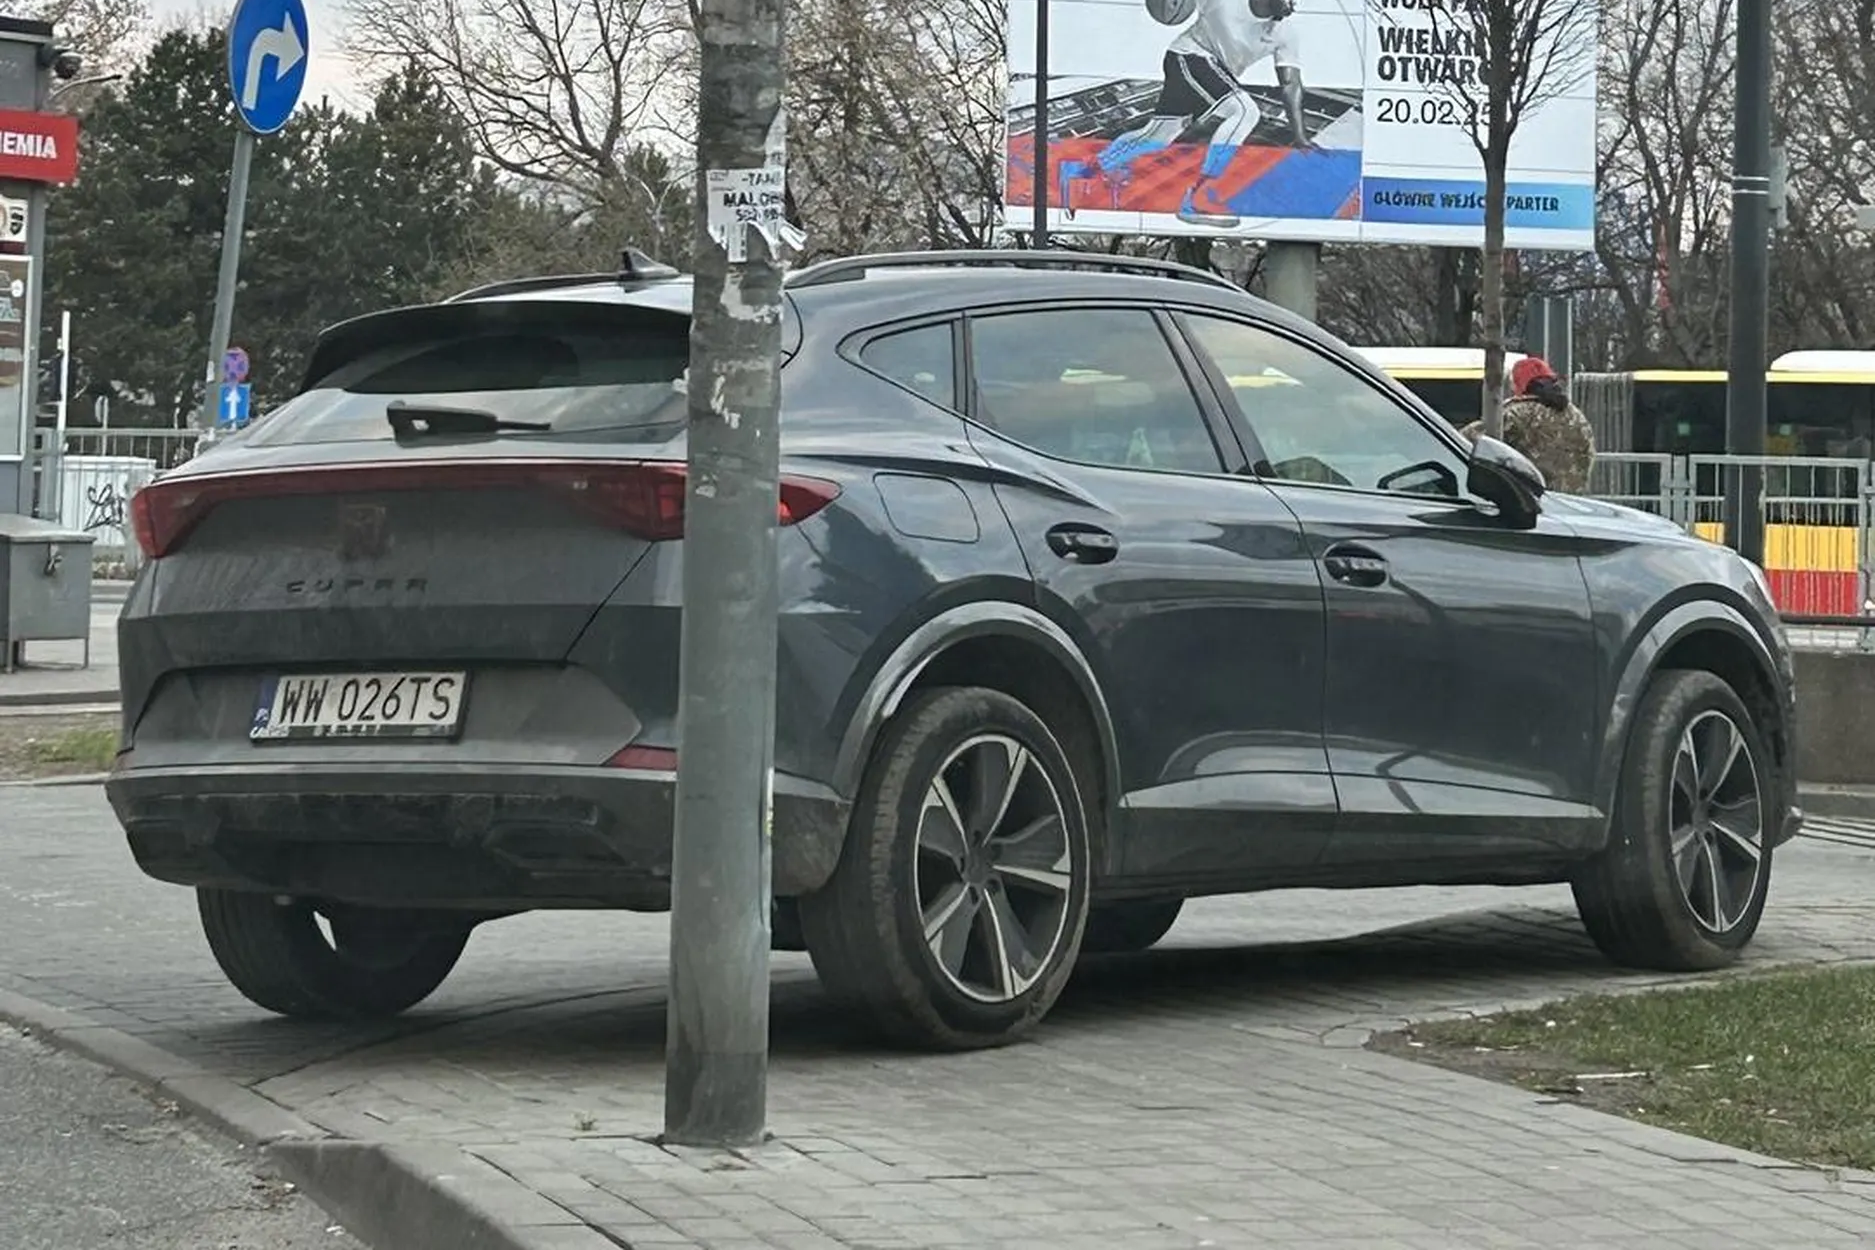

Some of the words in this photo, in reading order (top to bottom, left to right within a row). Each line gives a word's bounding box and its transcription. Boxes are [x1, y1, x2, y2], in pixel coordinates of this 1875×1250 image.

[0, 131, 57, 159] EMIA
[1506, 195, 1560, 212] PARTER
[280, 679, 329, 723] WW
[337, 676, 455, 722] 026TS
